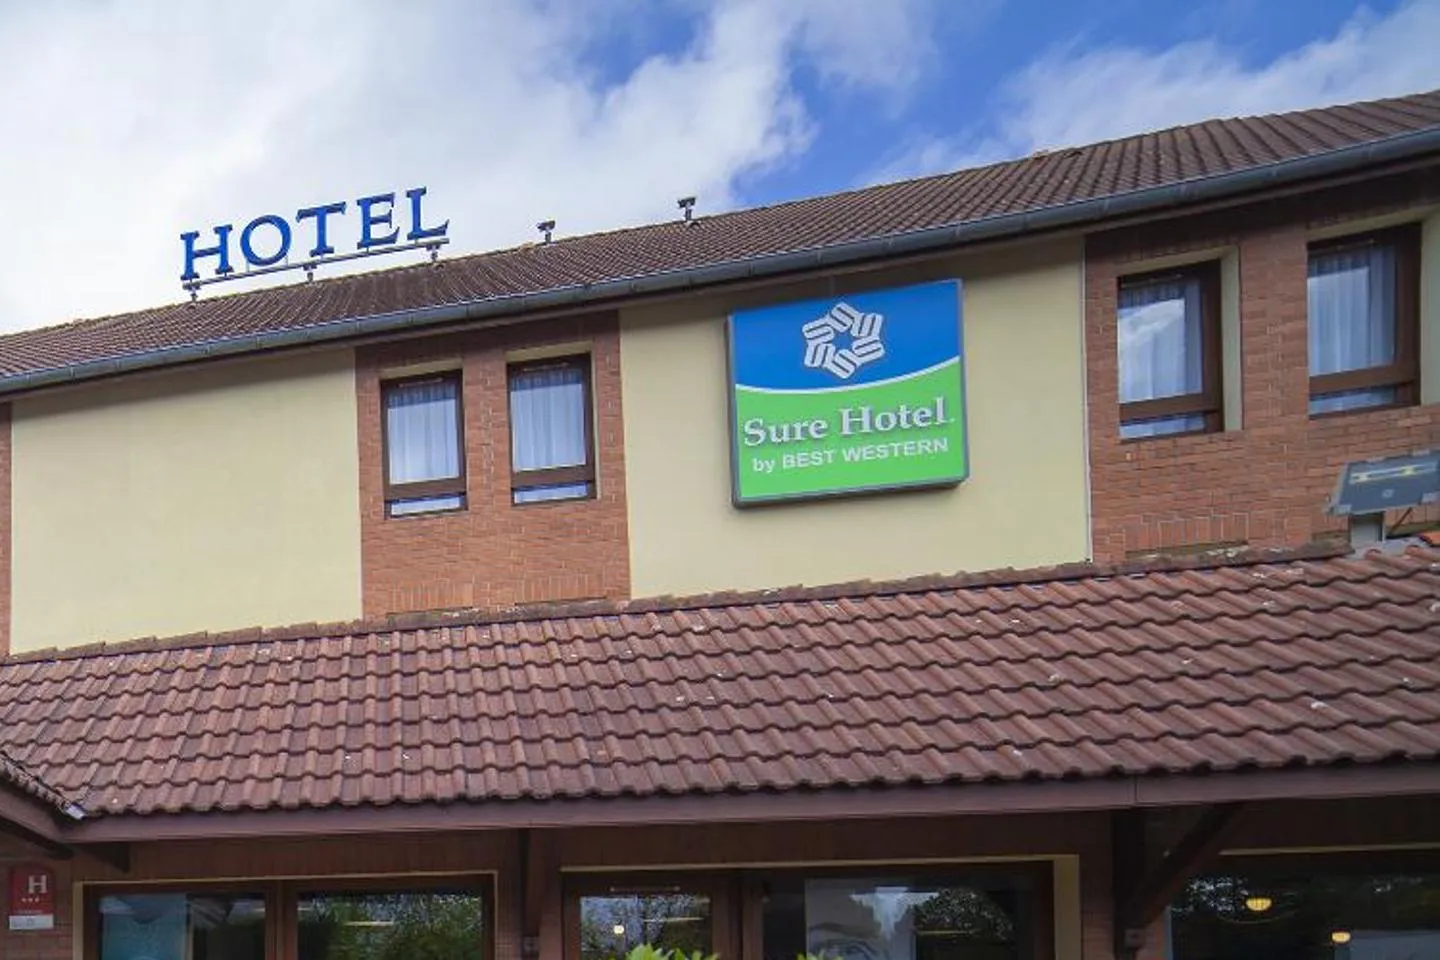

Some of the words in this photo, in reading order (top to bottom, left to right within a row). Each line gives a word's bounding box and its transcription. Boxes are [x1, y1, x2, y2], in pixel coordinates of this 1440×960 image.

[179, 185, 450, 281] HOTEL
[743, 417, 828, 447] Sure
[838, 396, 946, 436] Hotel
[752, 457, 776, 474] by
[782, 449, 836, 469] BEST
[842, 437, 949, 463] WESTERN
[28, 874, 48, 894] H
